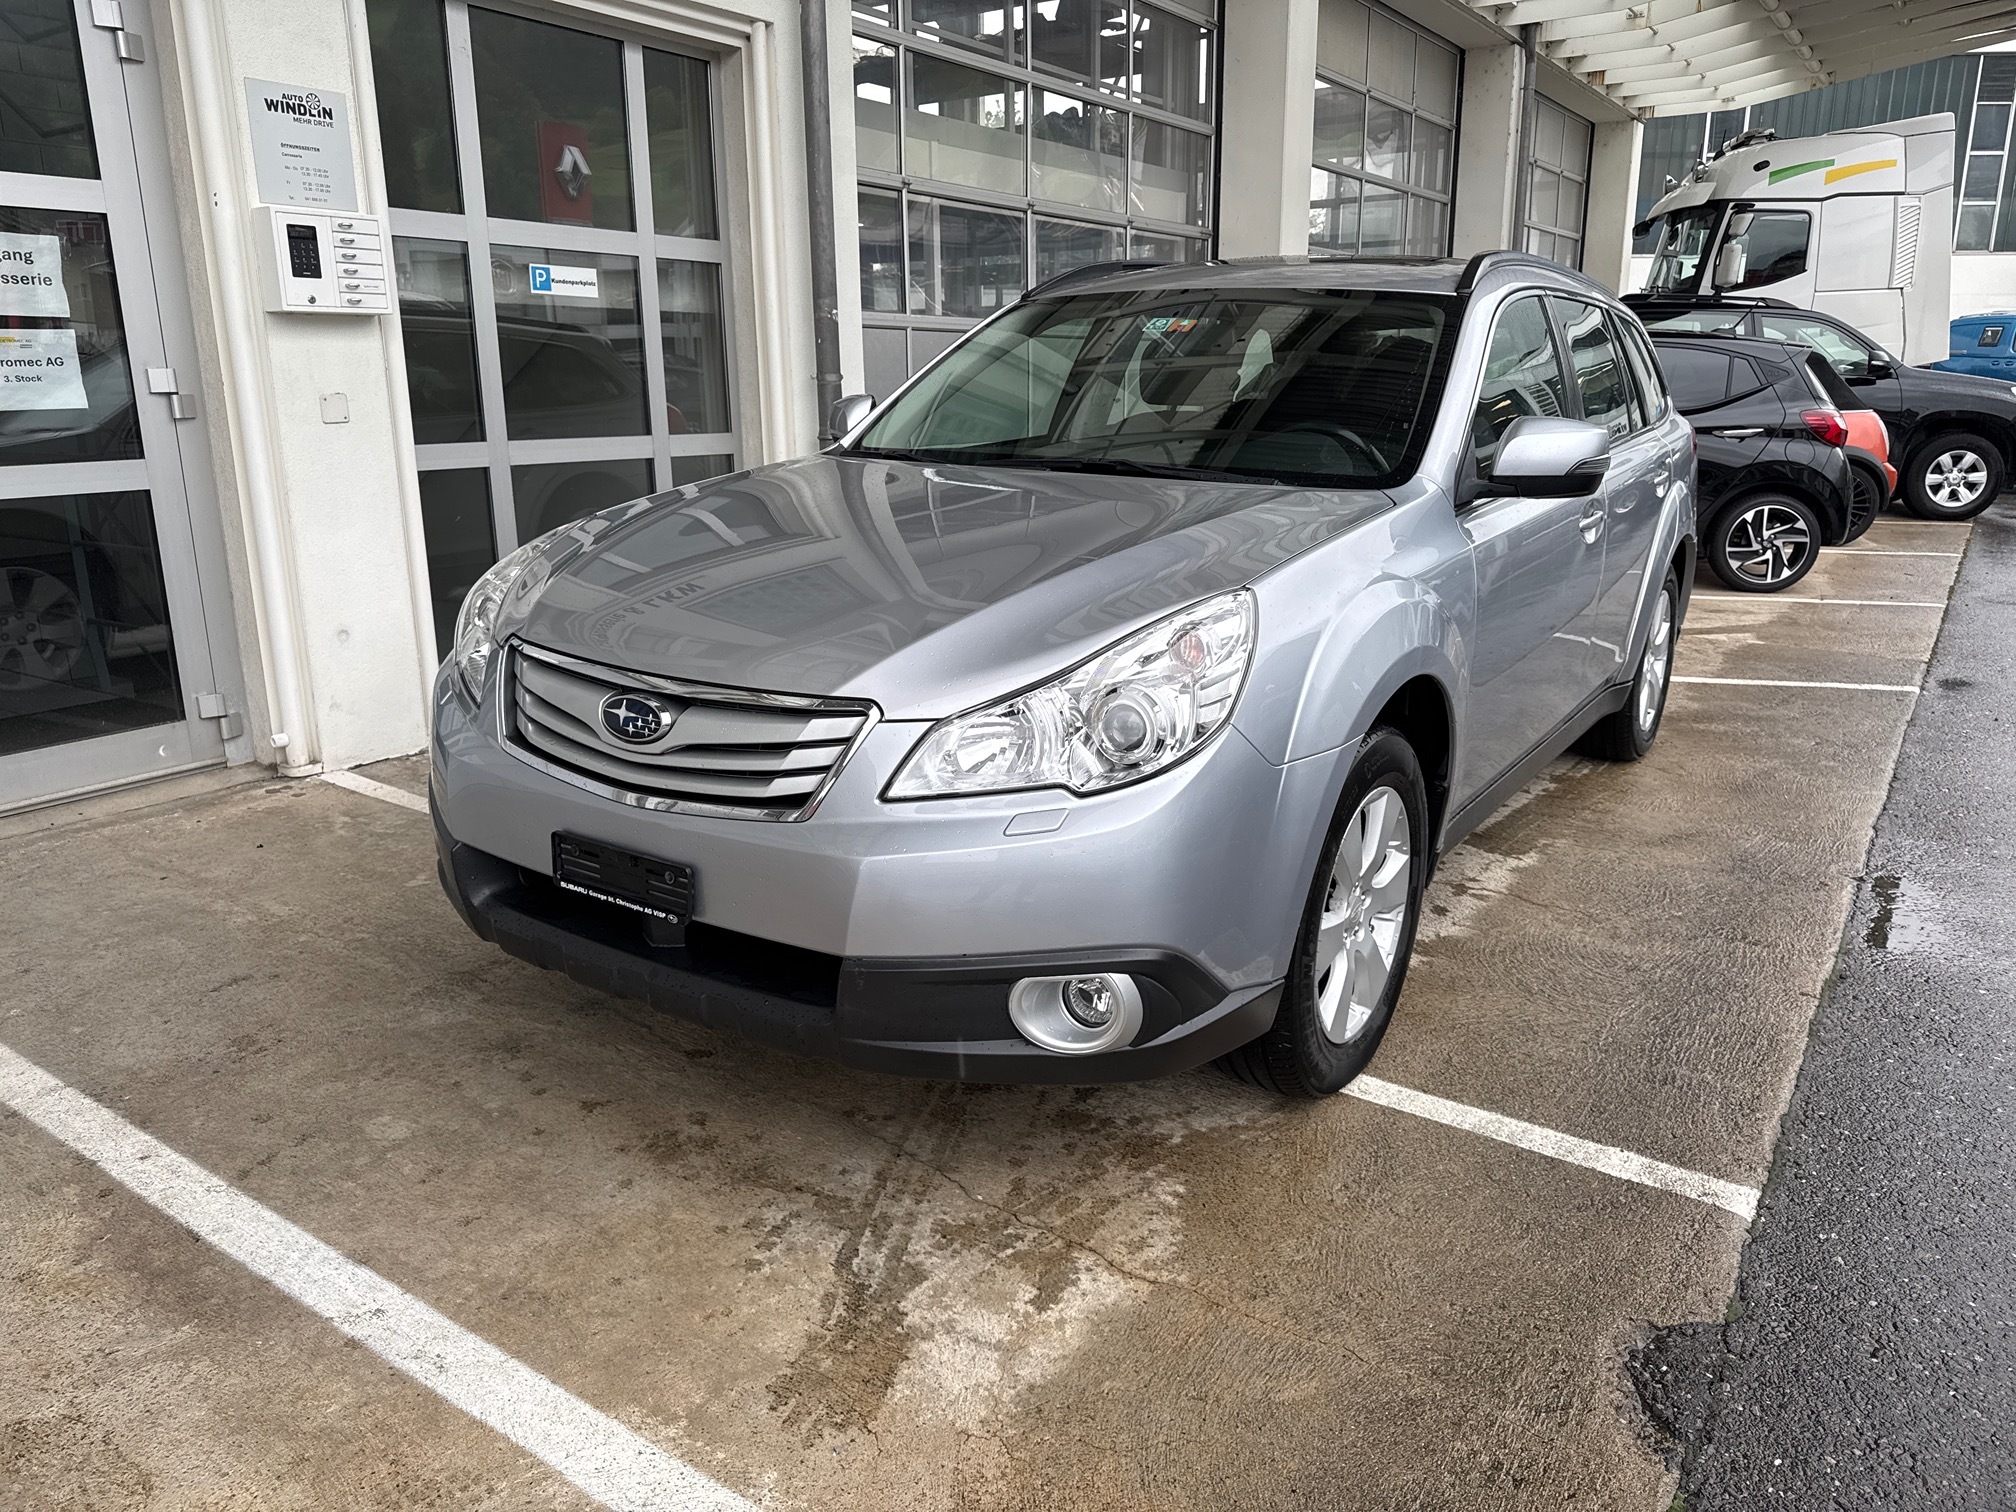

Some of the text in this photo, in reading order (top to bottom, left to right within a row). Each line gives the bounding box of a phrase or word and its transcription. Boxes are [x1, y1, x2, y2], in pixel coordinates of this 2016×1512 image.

[281, 92, 304, 103] AUTO
[263, 97, 334, 121] WINDLIN
[293, 116, 334, 129] MEHR DRIVE
[0, 250, 34, 265] ang
[535, 269, 547, 288] P
[551, 278, 596, 287] Kundenparkplatz
[46, 356, 64, 367] AG
[4, 374, 43, 383] 3. Stock
[560, 881, 588, 895] SUBARU
[588, 889, 607, 901] Garage
[615, 898, 643, 912] Christophe
[644, 907, 652, 915] AG
[652, 909, 667, 919] VISP
